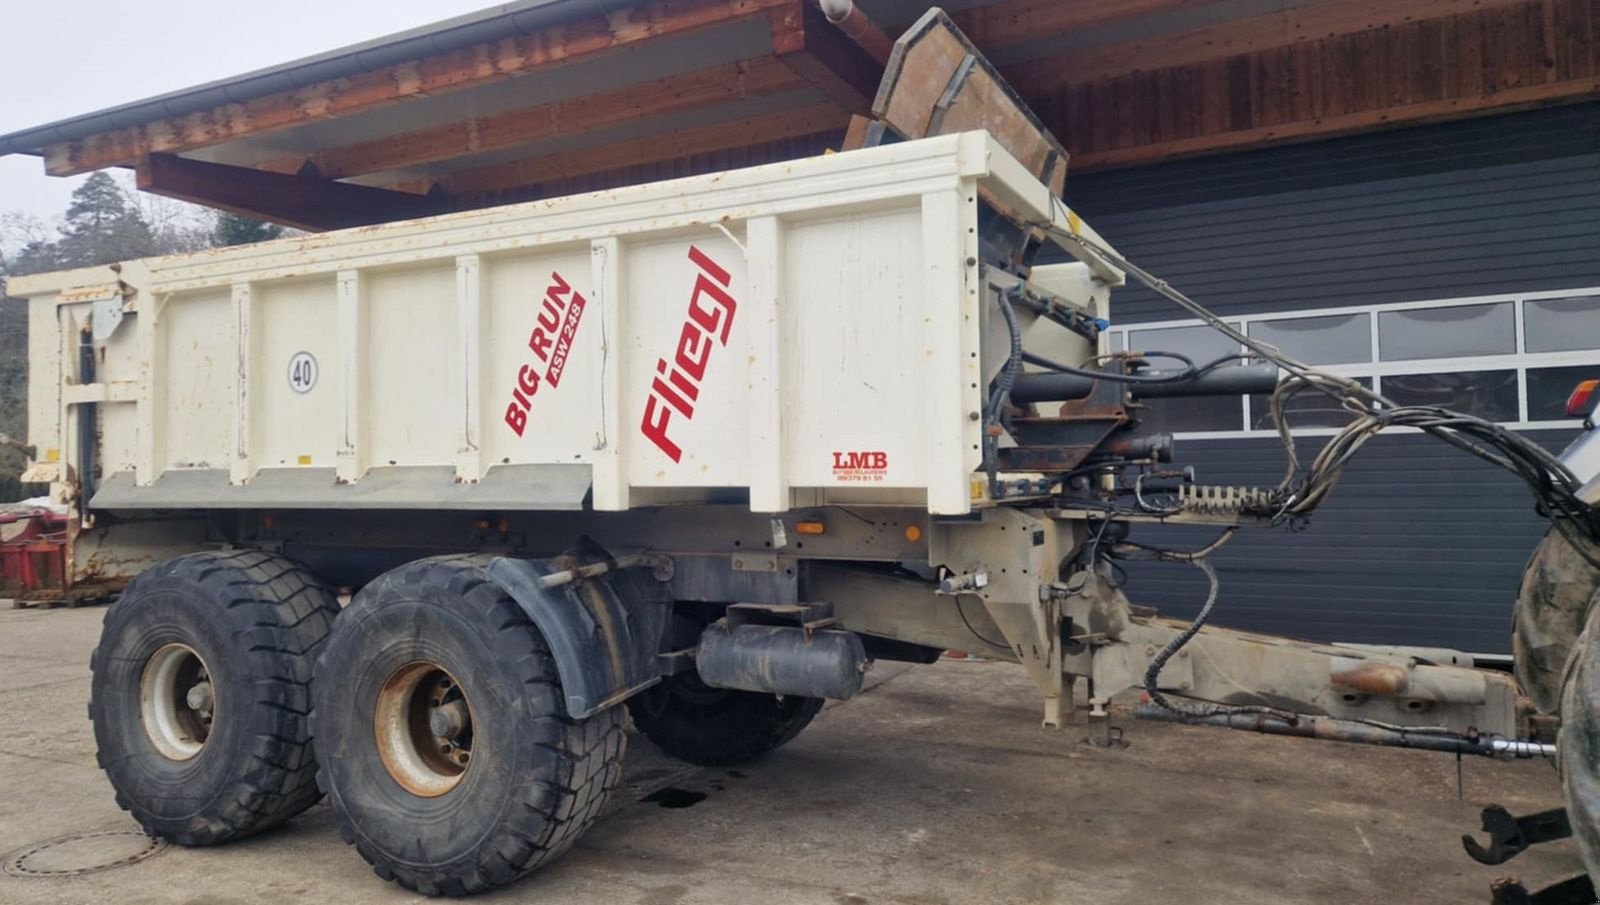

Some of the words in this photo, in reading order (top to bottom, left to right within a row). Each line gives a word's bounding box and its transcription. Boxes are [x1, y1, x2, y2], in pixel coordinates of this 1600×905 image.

[293, 360, 311, 386] 40
[504, 364, 541, 438] BIG
[528, 271, 571, 363] RUN
[551, 342, 569, 381] ASW
[564, 302, 581, 337] 248
[641, 244, 737, 464] Fliegl
[832, 452, 888, 469] LMB
